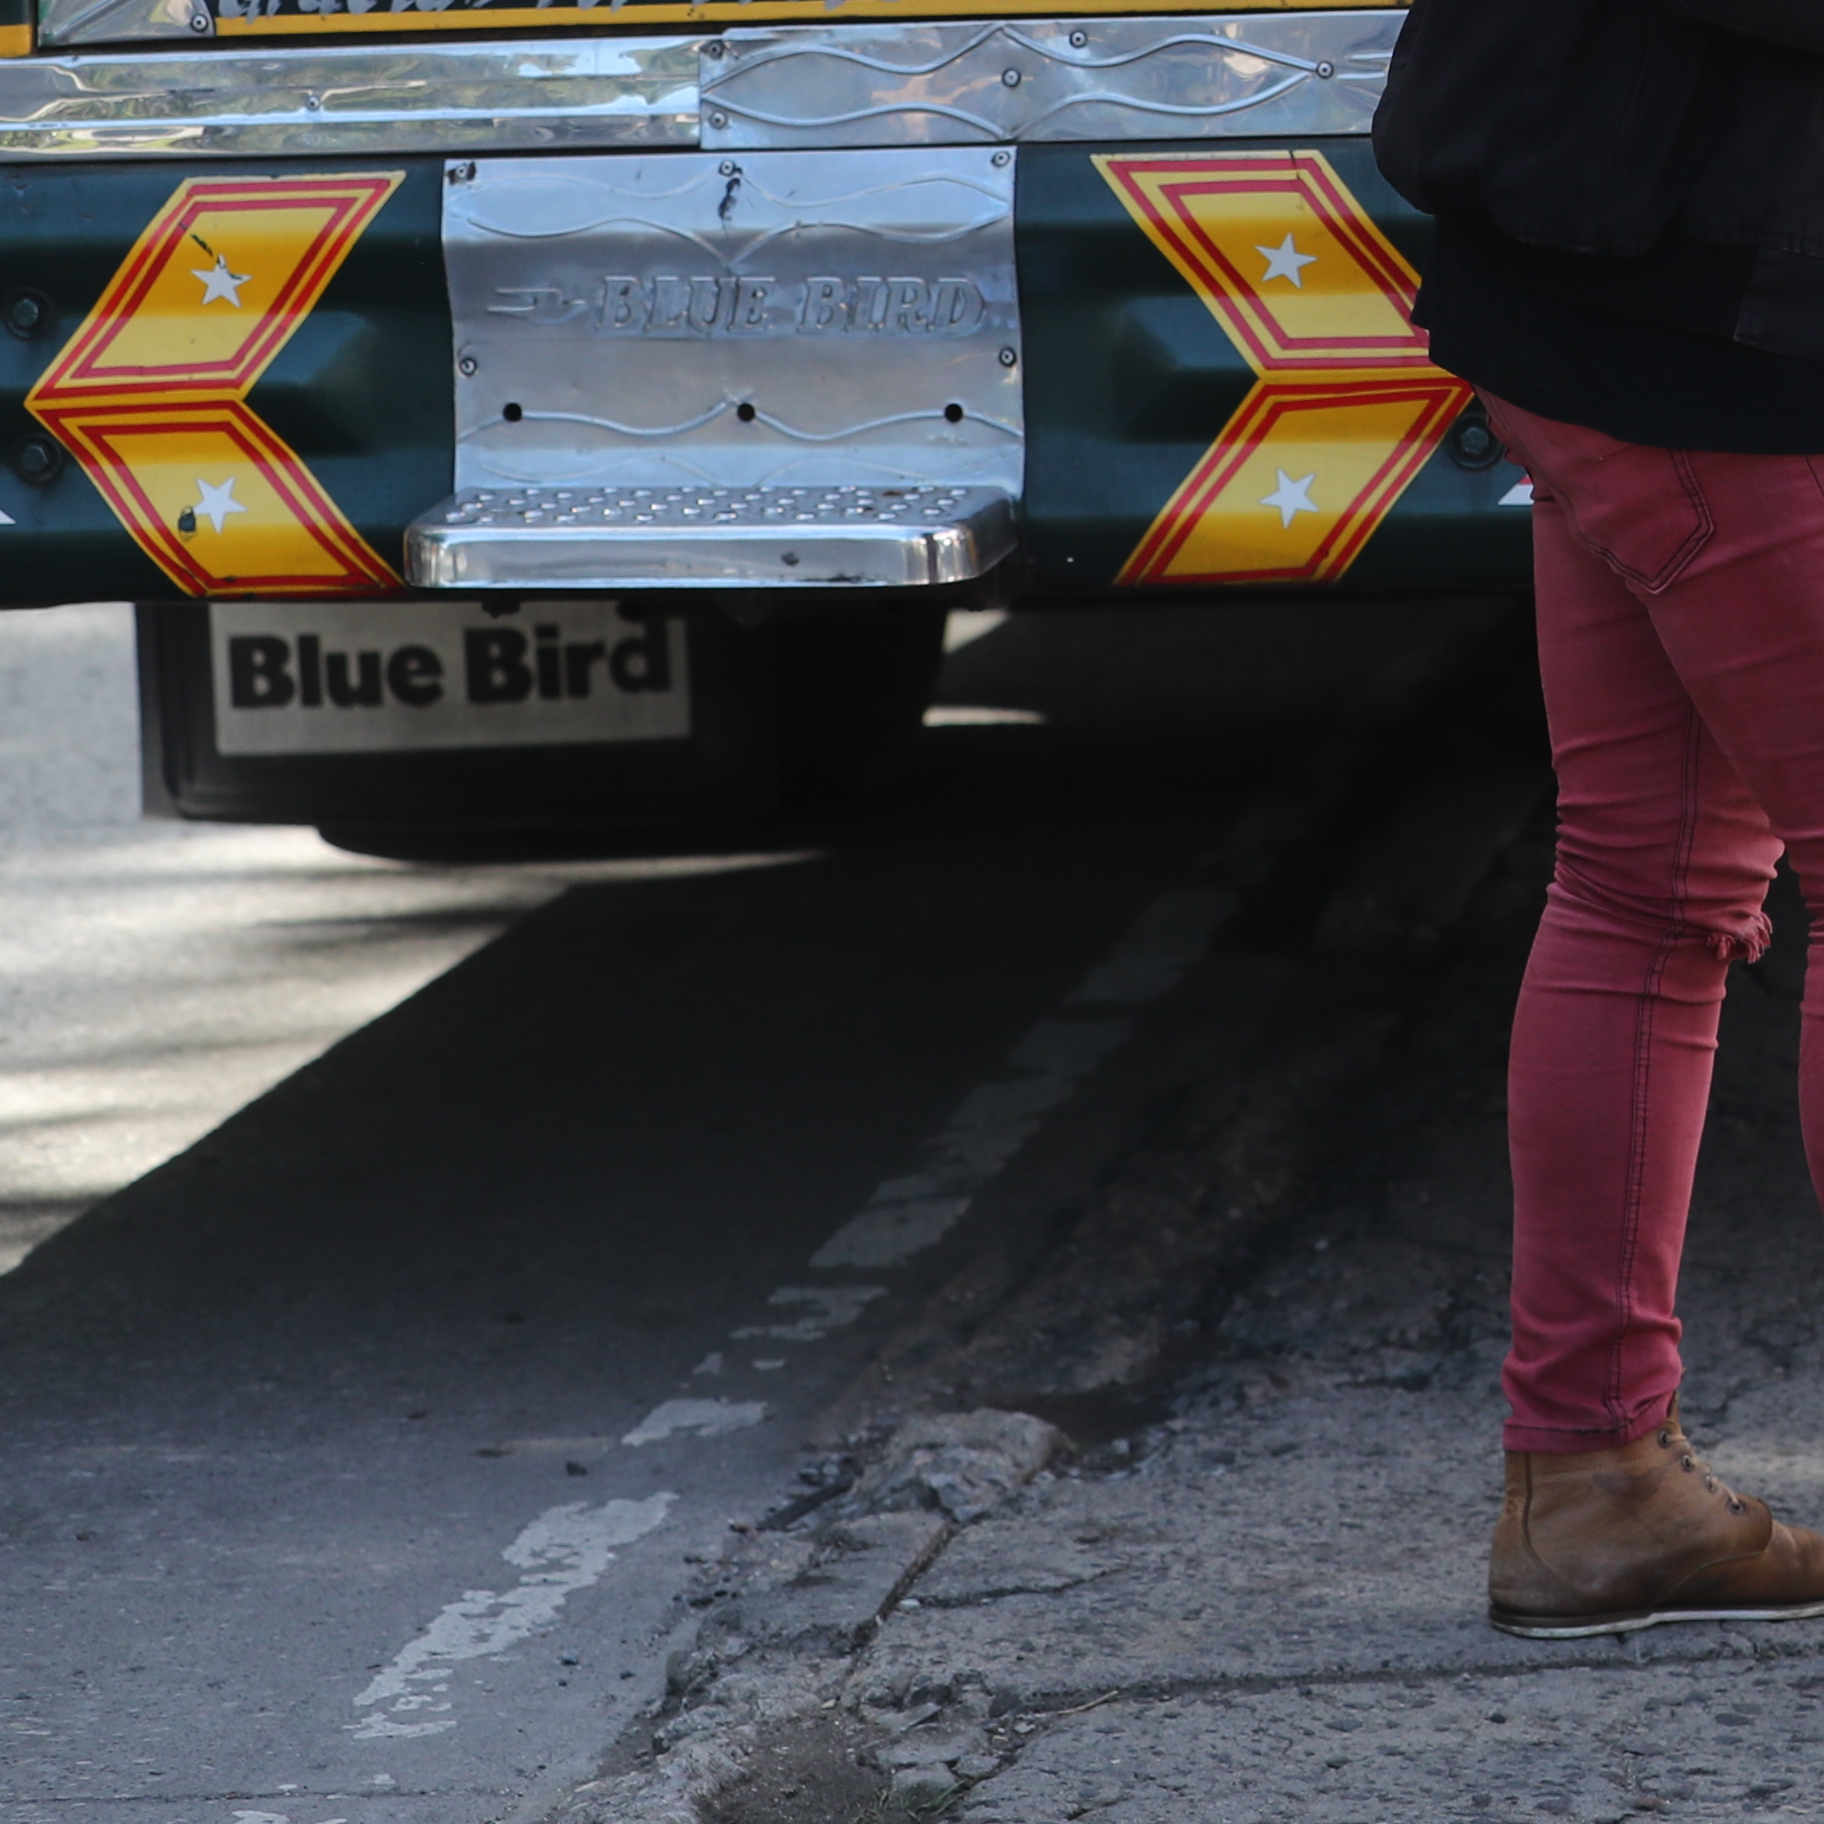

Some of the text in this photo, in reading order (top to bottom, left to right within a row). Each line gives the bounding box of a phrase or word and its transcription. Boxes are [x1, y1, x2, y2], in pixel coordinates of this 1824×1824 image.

[595, 276, 987, 337] BLUE BIRD
[228, 617, 672, 710] Blue Bird
